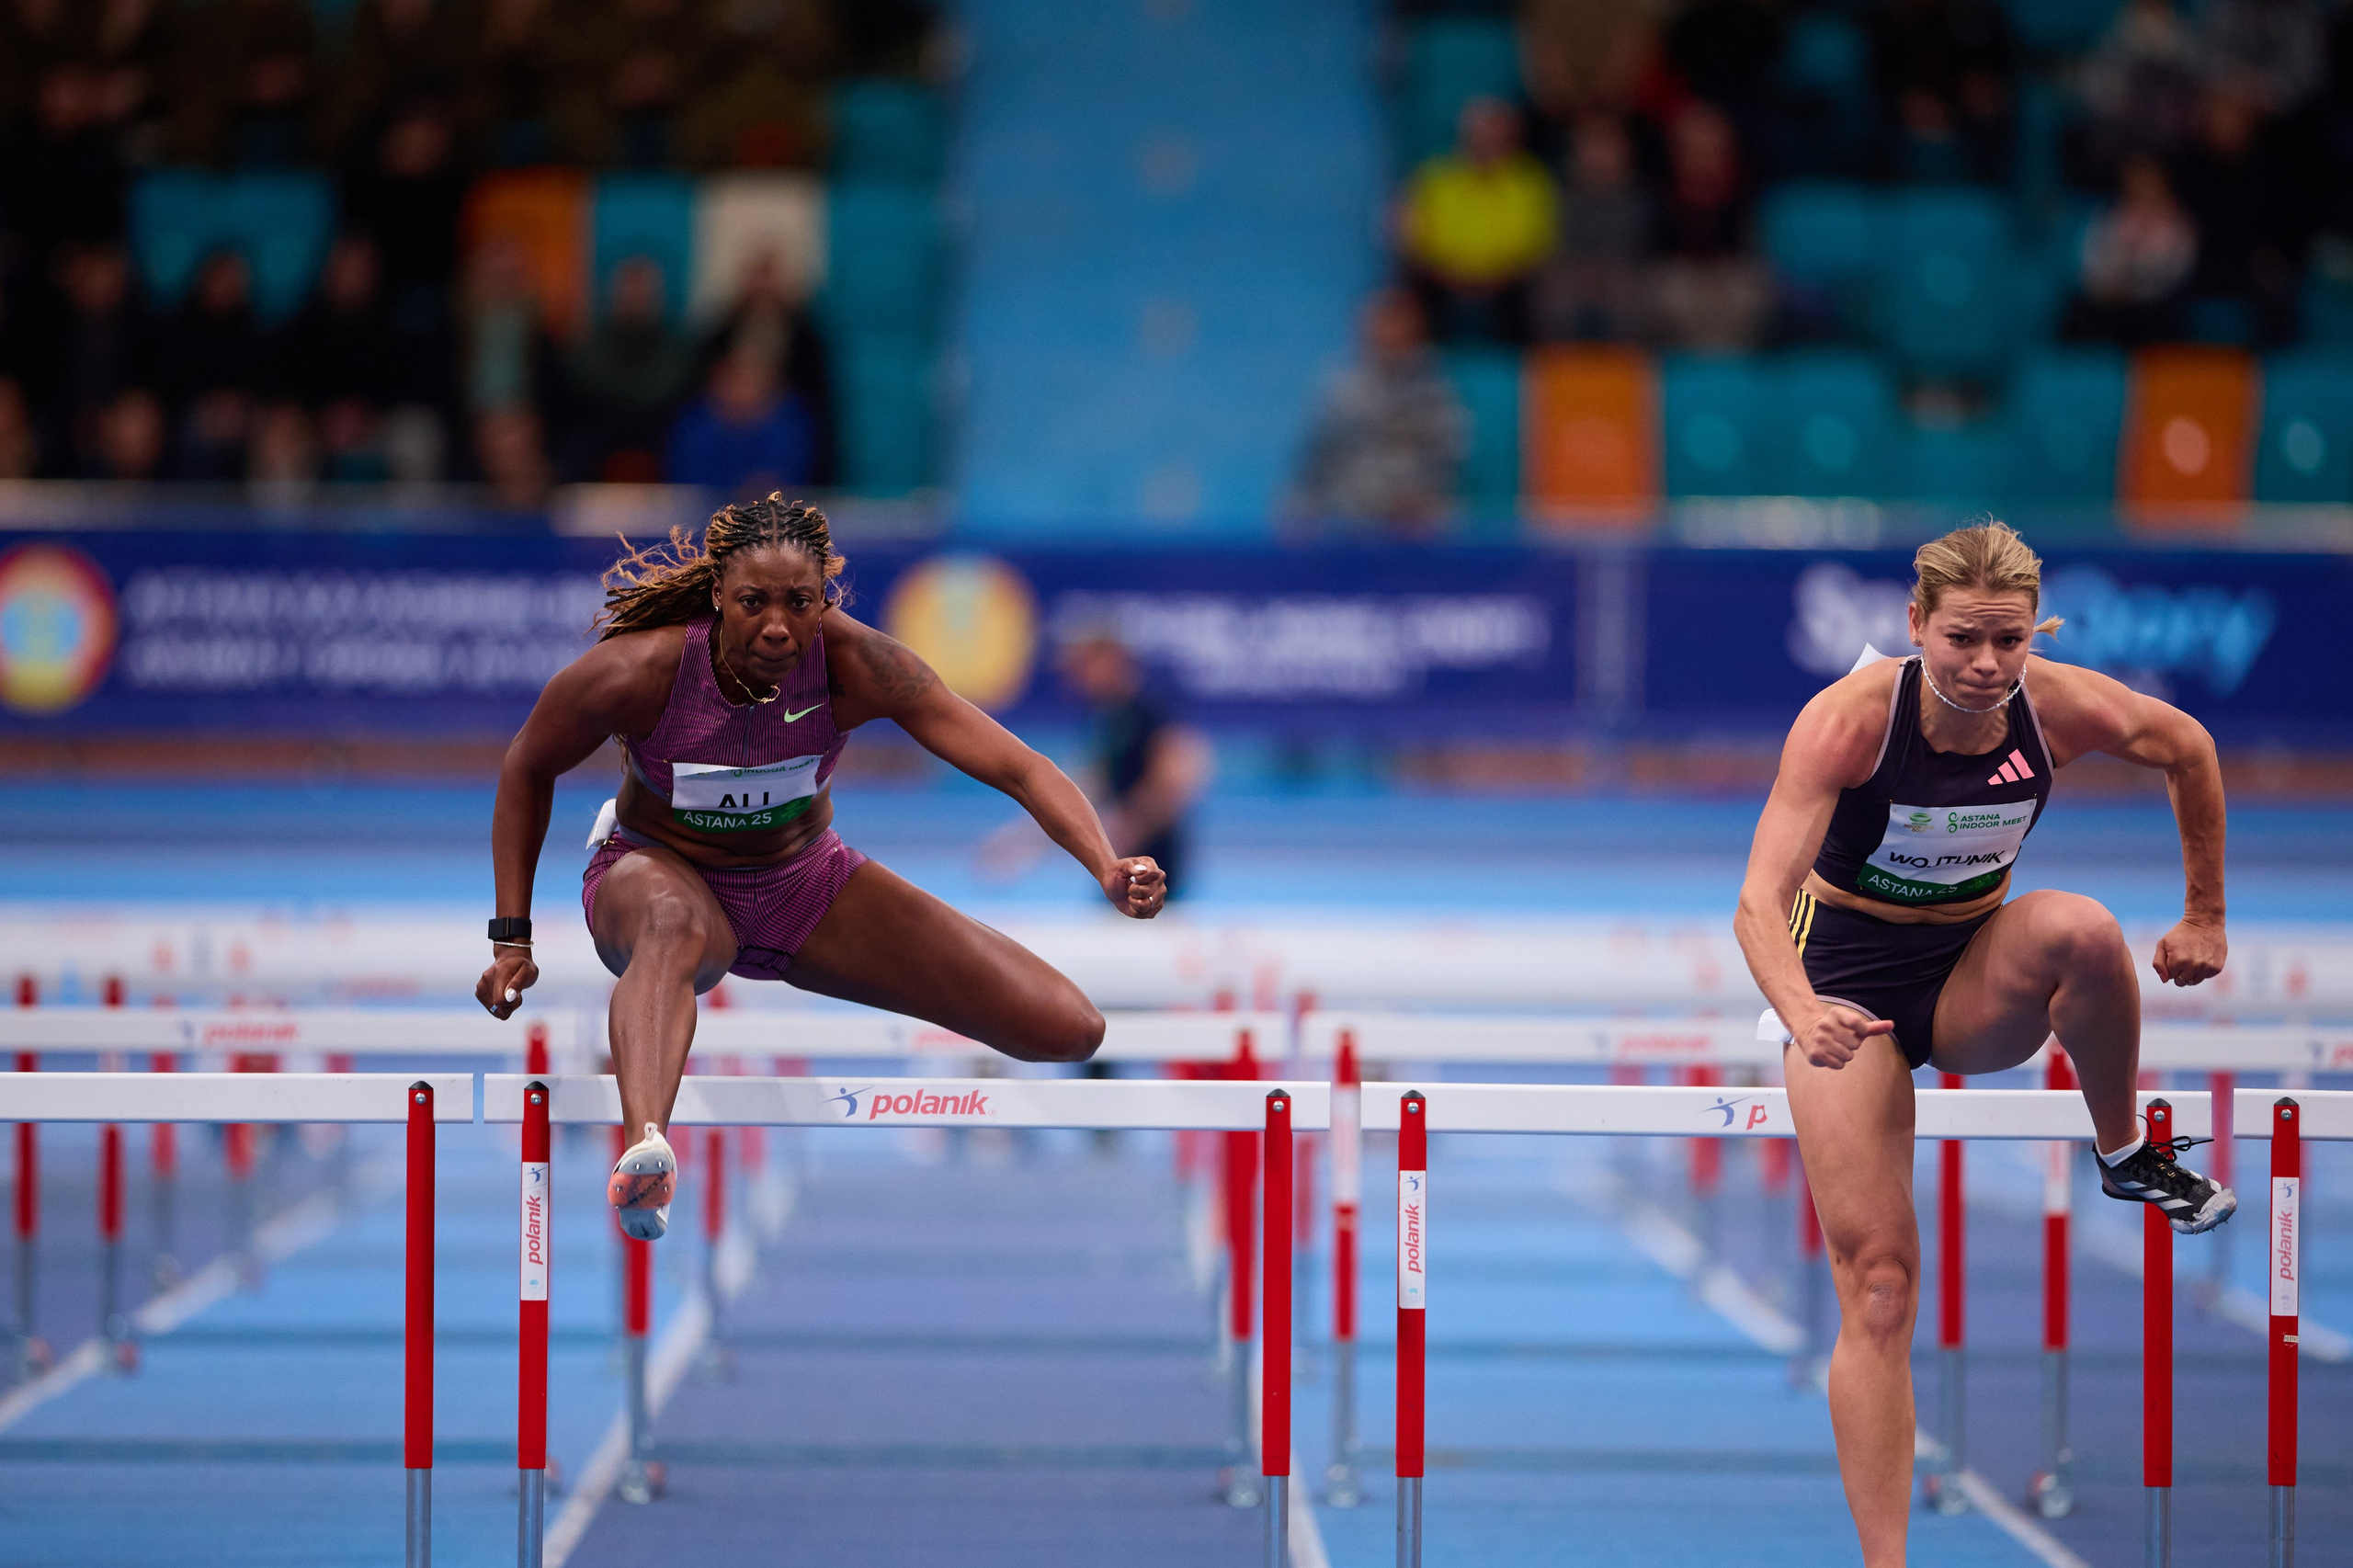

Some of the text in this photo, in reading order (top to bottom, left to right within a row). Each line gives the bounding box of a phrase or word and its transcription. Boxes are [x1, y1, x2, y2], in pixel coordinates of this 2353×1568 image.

[683, 811, 772, 828] ASTANA 25
[1959, 815, 2028, 830] INDOOR MEET
[1961, 813, 2001, 823] ASTANA
[1889, 850, 2006, 869] WOJTUNIK
[1867, 874, 1931, 897] ASTANA
[869, 1088, 990, 1120] polanik
[525, 1194, 544, 1266] polanik
[1404, 1202, 1423, 1274] polanik
[2277, 1210, 2295, 1281] polanik
